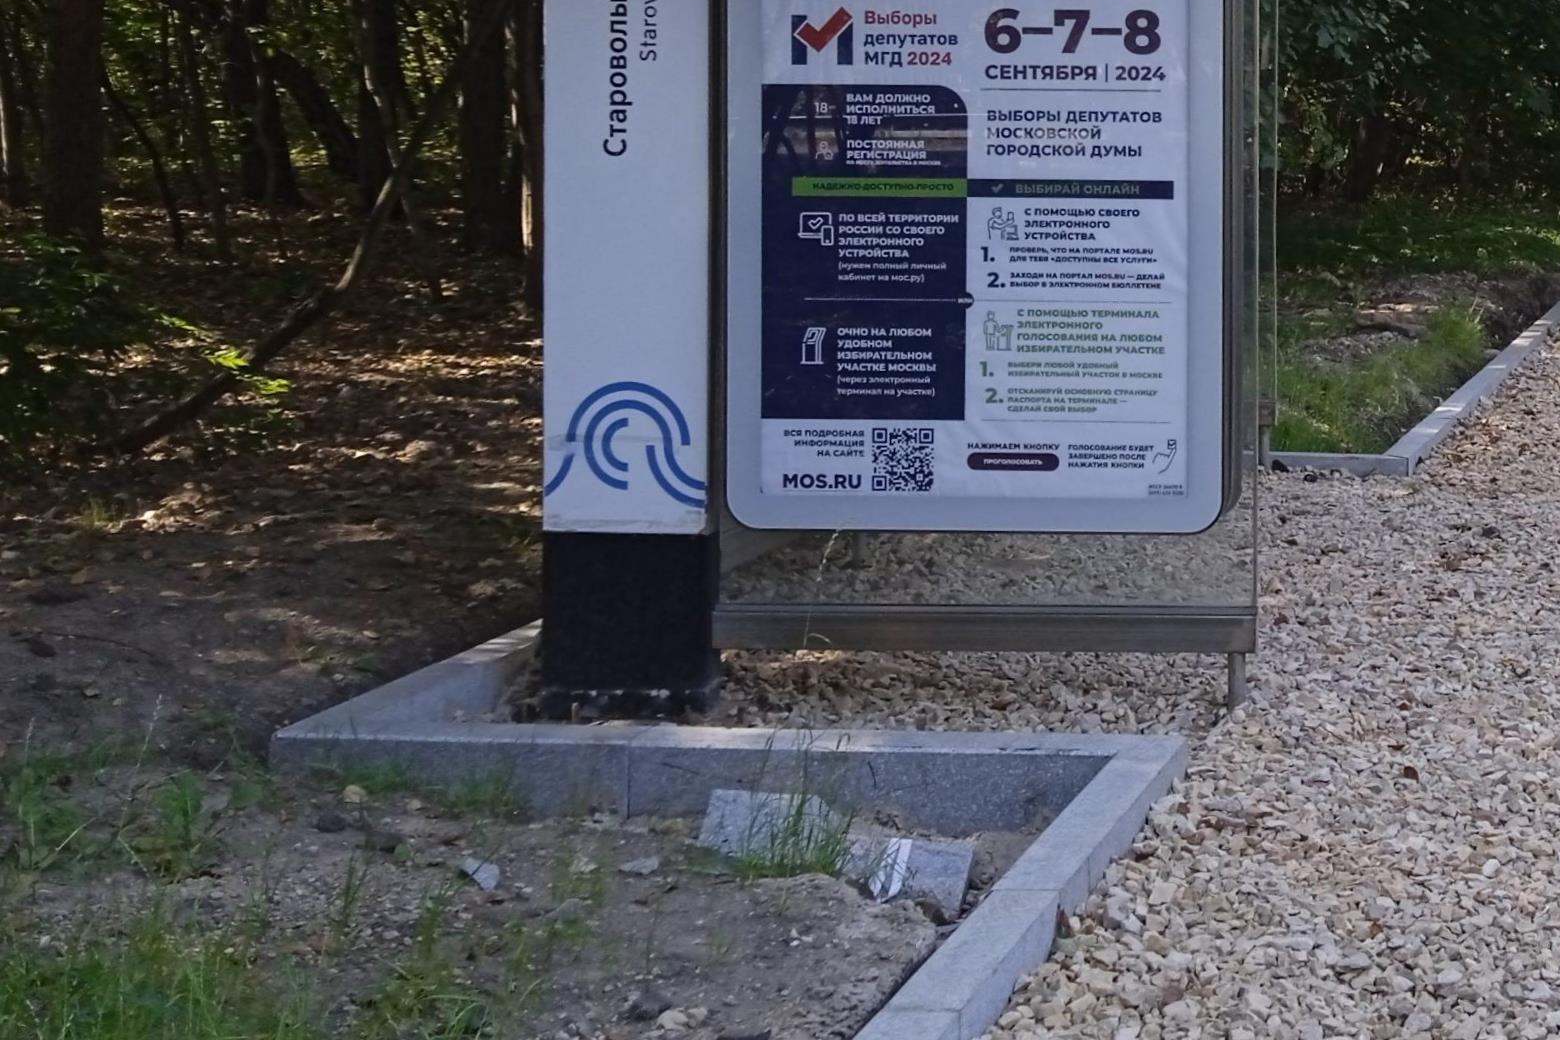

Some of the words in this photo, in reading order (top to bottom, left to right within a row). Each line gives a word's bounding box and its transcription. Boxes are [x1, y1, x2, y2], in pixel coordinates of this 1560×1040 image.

[864, 10, 937, 27] Выборы
[864, 30, 958, 49] депутатов
[864, 51, 902, 68] МГД
[906, 51, 952, 67] 2024
[985, 64, 1098, 81] СЕНТЯБРЯ
[1115, 66, 1166, 82] 2024
[846, 93, 873, 103] ВАМ
[875, 94, 931, 104] ДОЛЖНО
[846, 105, 935, 114] ИСПОЛНИТЬСЯ
[860, 116, 882, 125] ЛЕТ
[987, 110, 1061, 122] ВЫБОРЫ
[1065, 111, 1162, 124] ДЕПУТАТОВ
[987, 126, 1101, 140] МОСКОВСКОЙ
[846, 140, 925, 149] ПОСТОЯННАЯ
[987, 142, 1086, 158] ГОРОДСКОЙ
[1090, 145, 1142, 158] ДУМЫ
[846, 150, 926, 161] РЕГИСТРАЦИЯ
[1016, 182, 1080, 194] ВЫБИРАЙ
[1083, 183, 1140, 195] ОНЛАЙН
[838, 214, 855, 222] ПО
[857, 212, 886, 222] ВСЕЙ
[888, 214, 959, 223] ТЕРРИТОРИИ
[1024, 208, 1031, 216] С
[1034, 208, 1095, 218] ПОМОЩЬЮ
[1098, 209, 1140, 217] СВОЕГО
[1024, 220, 1110, 229] ЭЛЕКТРОННОГО
[838, 226, 883, 234] РОССИИ
[886, 226, 900, 234] СО
[903, 226, 945, 235] СВОЕГО
[1024, 230, 1096, 241] УСТРОЙСТВА
[838, 237, 924, 246] ЭЛЕКТРОННОГО
[838, 248, 909, 258] УСТРОЙСТВА
[980, 246, 995, 262] 1.
[838, 273, 876, 281] кабинет
[986, 272, 1006, 288] 2.
[1017, 309, 1024, 317] С
[1027, 309, 1089, 319] ПОМОЩЬЮ
[1092, 310, 1159, 319] ТЕРМИНАЛА
[1017, 321, 1103, 330] ЭЛЕКТРОННОГО
[837, 327, 868, 337] ОЧНО
[871, 327, 886, 337] НА
[889, 328, 931, 337] ЛЮБОМ
[1017, 333, 1098, 342] ГОЛОСОВАНИЯ
[1101, 334, 1117, 342] НА
[1119, 334, 1162, 343] ЛЮБОМ
[837, 340, 892, 349] УДОБНОМ
[1017, 345, 1113, 354] ИЗБИРАТЕЛЬНОМ
[1115, 346, 1165, 355] УЧАСТКЕ
[837, 351, 932, 360] ИЗБИРАТЕЛЬНОМ
[837, 363, 886, 372] УЧАСТКЕ
[888, 363, 936, 372] МОСКВЫ
[979, 361, 994, 377] 1.
[985, 387, 1004, 404] 2.
[804, 430, 865, 438] ПОДРОБНАЯ
[794, 440, 865, 448] ИНФОРМАЦИЯ
[817, 449, 832, 457] НА
[833, 448, 865, 457] САЙТЕ
[783, 474, 862, 489] MOS.RU
